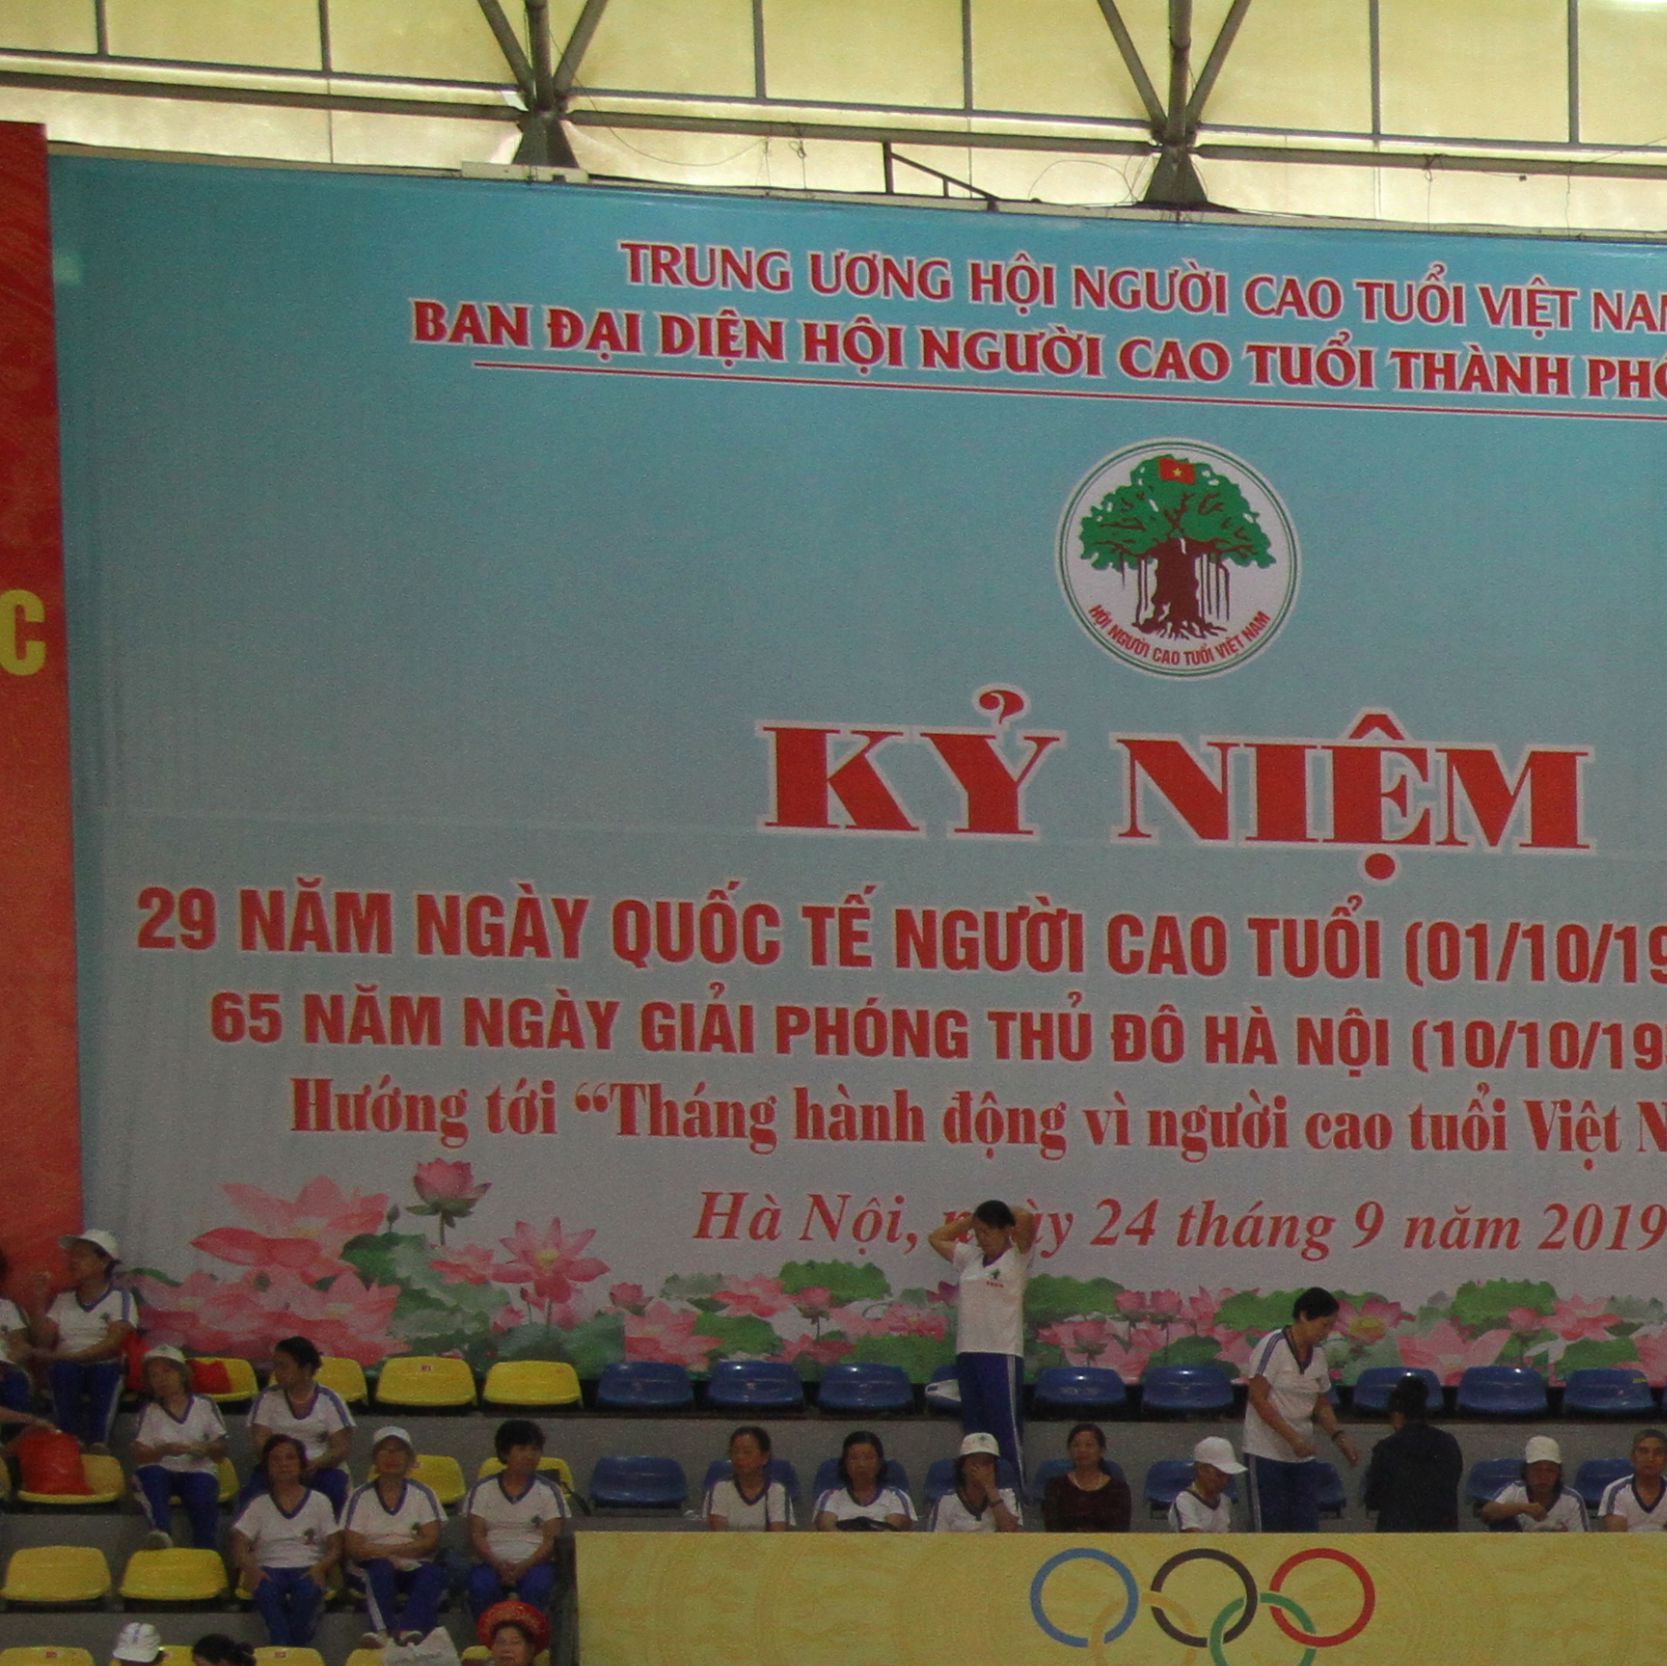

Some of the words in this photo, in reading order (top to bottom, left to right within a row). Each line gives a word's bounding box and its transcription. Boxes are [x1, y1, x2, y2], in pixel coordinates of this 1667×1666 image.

[621, 242, 790, 291] TRUNG
[811, 253, 951, 300] ƯƠNG
[971, 253, 1055, 313] HỘI
[1075, 262, 1227, 313] NGƯỜI
[1245, 276, 1342, 318] CAO
[1356, 264, 1464, 324] TUỔI
[1480, 278, 1578, 336] VIỆT
[414, 301, 529, 347] BAN
[546, 308, 640, 360] ĐẠI
[661, 309, 784, 366] DIỆN
[804, 316, 903, 373] HỘI
[921, 326, 1101, 376] NGƯỜI
[1119, 338, 1230, 381] CAO
[1246, 331, 1373, 388] TUỔI
[1391, 344, 1570, 395] THÀNH
[1088, 604, 1110, 629] HỘI
[1107, 626, 1150, 657] NGƯỜI
[1152, 647, 1180, 665] CAO
[1184, 644, 1215, 665] TUỔI
[1215, 634, 1243, 660] VIỆT
[1241, 610, 1271, 644] NAM
[768, 686, 1060, 836] KỶ
[1116, 713, 1590, 881] NIỆM
[136, 886, 218, 951] 29
[238, 876, 394, 956] NĂM
[415, 882, 591, 960] NGÀY
[611, 880, 783, 970] QUỐC
[800, 884, 877, 969] TẾ
[894, 894, 1086, 975] NGƯỜI
[1106, 913, 1229, 977] CAO
[1246, 893, 1382, 980] TUỔI
[209, 990, 284, 1045] 65
[302, 983, 443, 1048] NĂM
[462, 987, 621, 1051] NGÀY
[640, 980, 756, 1055] GIẢI
[774, 996, 971, 1060] PHÓNG
[986, 990, 1094, 1063] THỦ
[1110, 1003, 1186, 1065] ĐÔ
[1203, 1005, 1280, 1066] HÀ
[1295, 1007, 1391, 1079] NỘI
[289, 1074, 470, 1150] Hướng
[485, 1077, 558, 1136] tới
[573, 1081, 779, 1156] “Tháng
[792, 1084, 927, 1144] hành
[941, 1089, 1069, 1163] động
[1083, 1091, 1132, 1147] vì
[1147, 1090, 1290, 1164] người
[1303, 1111, 1396, 1152] cao
[1408, 1082, 1508, 1153] tuổi
[1522, 1098, 1620, 1172] Việt
[692, 1189, 783, 1243] Hà
[800, 1191, 920, 1255] Nội,
[1090, 1197, 1160, 1248] 24
[1176, 1198, 1339, 1264] tháng
[1352, 1200, 1385, 1249] 9
[1403, 1206, 1523, 1252] năm
